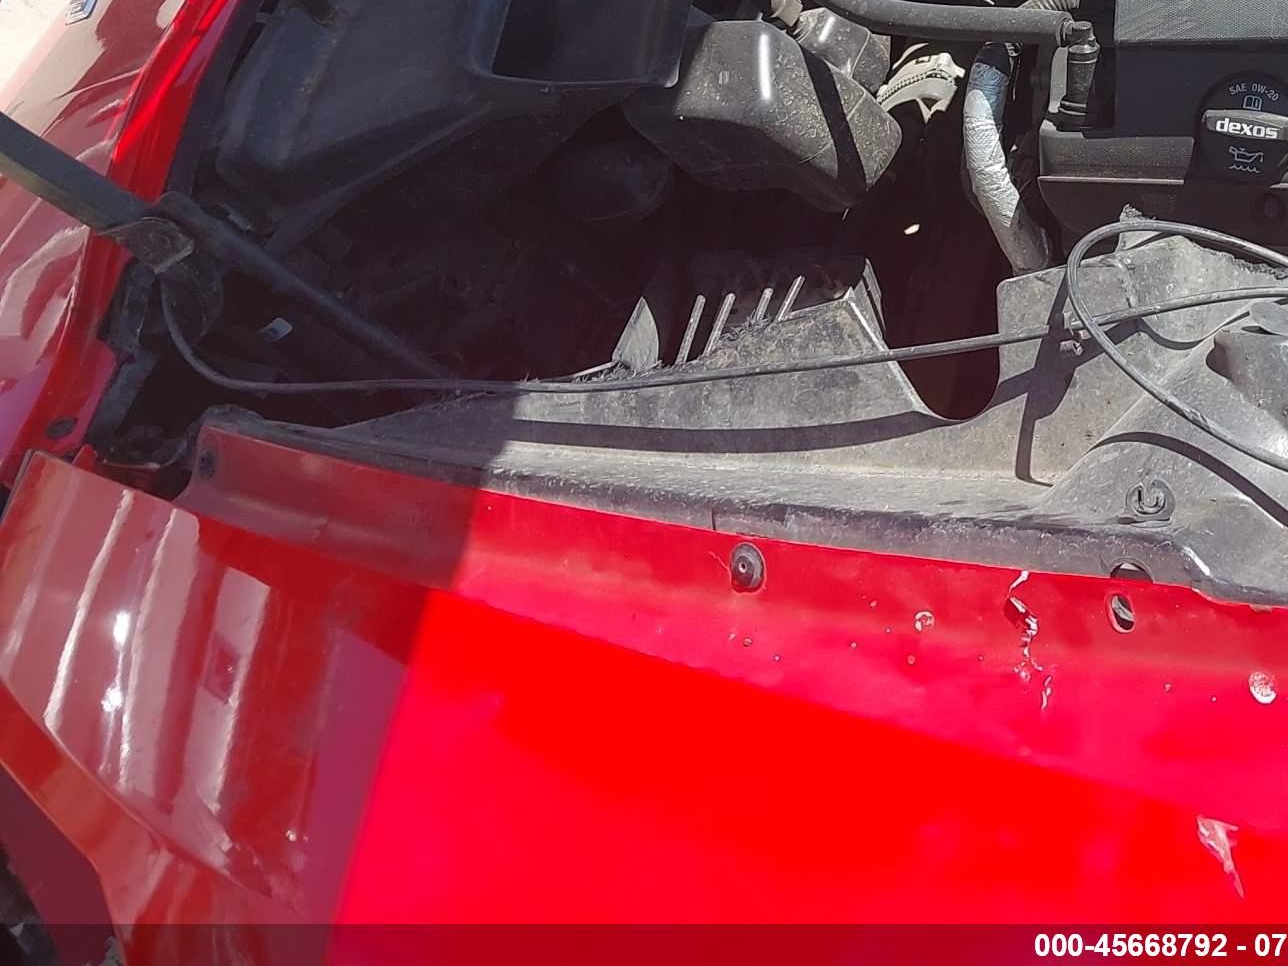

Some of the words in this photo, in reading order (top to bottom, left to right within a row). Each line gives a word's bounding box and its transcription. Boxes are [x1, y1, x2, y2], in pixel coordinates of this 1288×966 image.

[1228, 82, 1248, 96] SAE
[1251, 83, 1280, 102] 0W-20
[1215, 117, 1281, 139] dexos
